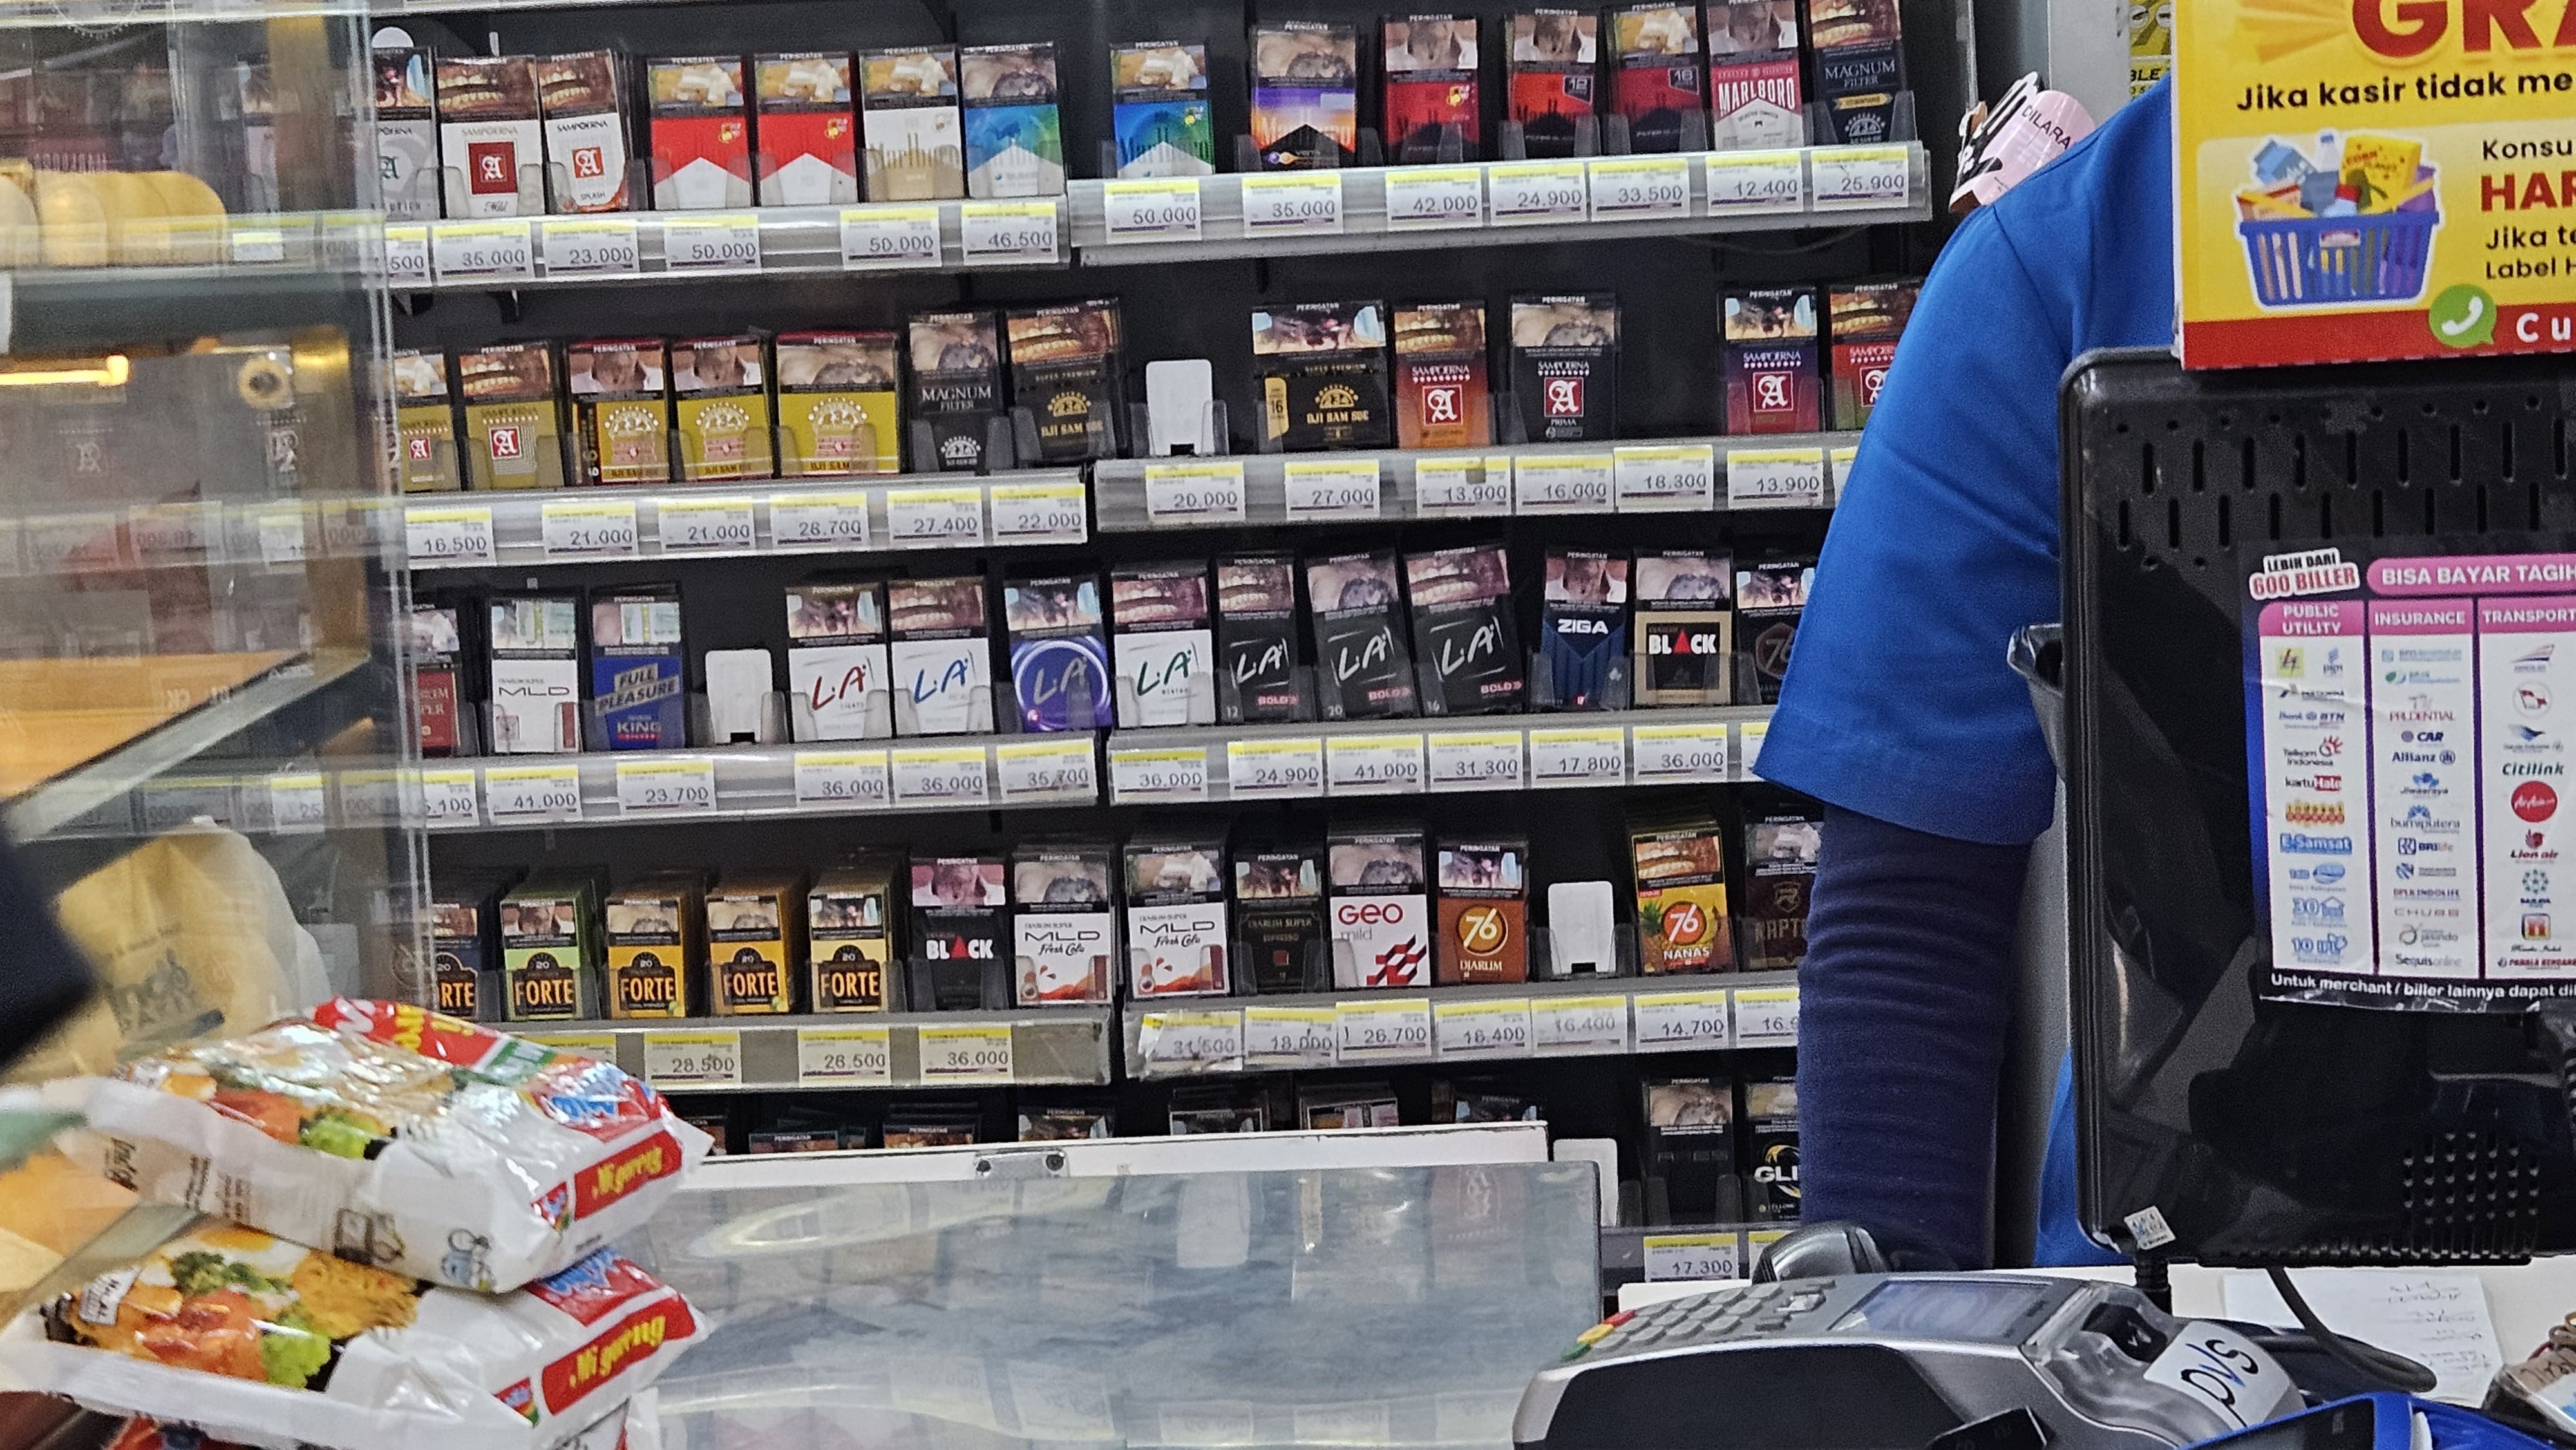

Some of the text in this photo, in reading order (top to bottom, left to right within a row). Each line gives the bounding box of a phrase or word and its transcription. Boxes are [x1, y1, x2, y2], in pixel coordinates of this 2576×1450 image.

[1824, 60, 1895, 80] MAGNUM
[1844, 75, 1879, 88] FILTER
[1718, 76, 1795, 117] MARLBORO
[2237, 83, 2308, 111] Jika
[2319, 77, 2405, 106] kasir
[2416, 70, 2505, 100] tidak
[1734, 179, 1797, 198] 12.400
[1841, 174, 1904, 193] 25.900
[1517, 190, 1582, 209] 24.900
[1618, 185, 1683, 203] 33.500
[1413, 194, 1477, 213] 42.000
[870, 236, 934, 252] 50.000
[989, 231, 1053, 248] 46.500
[2486, 226, 2548, 250] Jika
[569, 248, 634, 265] 23.000
[692, 243, 756, 260] 50.000
[2486, 257, 2557, 279] Label
[1743, 350, 1801, 362] SAMPOERNA
[1412, 365, 1470, 377] SAMPOERNA
[922, 386, 992, 402] MAGNUM
[940, 400, 974, 411] FILTER
[1544, 482, 1607, 500] 16.000
[1756, 476, 1819, 493] 13.900
[1174, 491, 1238, 507] 20.000
[1312, 489, 1374, 505] 27.000
[1445, 485, 1507, 503] 13.900
[914, 517, 978, 534] 27.400
[1018, 513, 1082, 529] 22.000
[570, 529, 633, 546] 21.000
[688, 525, 750, 540] 21.000
[425, 537, 487, 554] 16.500
[2267, 554, 2336, 572] LEBIH DARI
[2255, 567, 2356, 596] 600 BILLER
[2382, 567, 2431, 585] BISA
[2437, 565, 2510, 585] BAYAR
[2283, 604, 2338, 618] PUBLIC
[2374, 610, 2465, 625] INSURANCE
[1558, 619, 1609, 635] ZIGA
[2282, 621, 2341, 635] UTILITY
[618, 669, 656, 689] FULL
[498, 687, 571, 697] MLD
[598, 678, 677, 709] PLEASURE
[616, 720, 662, 735] KING
[2417, 731, 2444, 742] CAR
[1560, 757, 1621, 773] 17.800
[1661, 752, 1723, 768] 36.000
[2392, 752, 2436, 762] Allianz
[1255, 767, 1318, 784] 24.900
[1355, 762, 1417, 779] 41.000
[1456, 760, 1518, 775] 31.300
[822, 779, 884, 796] 36.000
[922, 776, 983, 793] 36.000
[515, 793, 576, 809] 41.000
[645, 787, 709, 804] 23.700
[1025, 931, 1101, 941] MLD
[1139, 921, 1215, 934] MLD
[1340, 927, 1374, 941] mild
[1663, 946, 1710, 961] NANAS
[1460, 960, 1502, 972] DJARUM
[515, 979, 574, 1005] FORTE
[620, 977, 675, 1001] FORTE
[723, 972, 779, 996] FORTE
[820, 971, 880, 997] FORTE
[2271, 973, 2554, 1001] Untuk merchant biller lainnya dapat
[1662, 1019, 1724, 1037] 14.700
[672, 1057, 735, 1073] 28.500
[948, 1051, 1009, 1066] 36.000
[1672, 1259, 1733, 1276] 17.300
